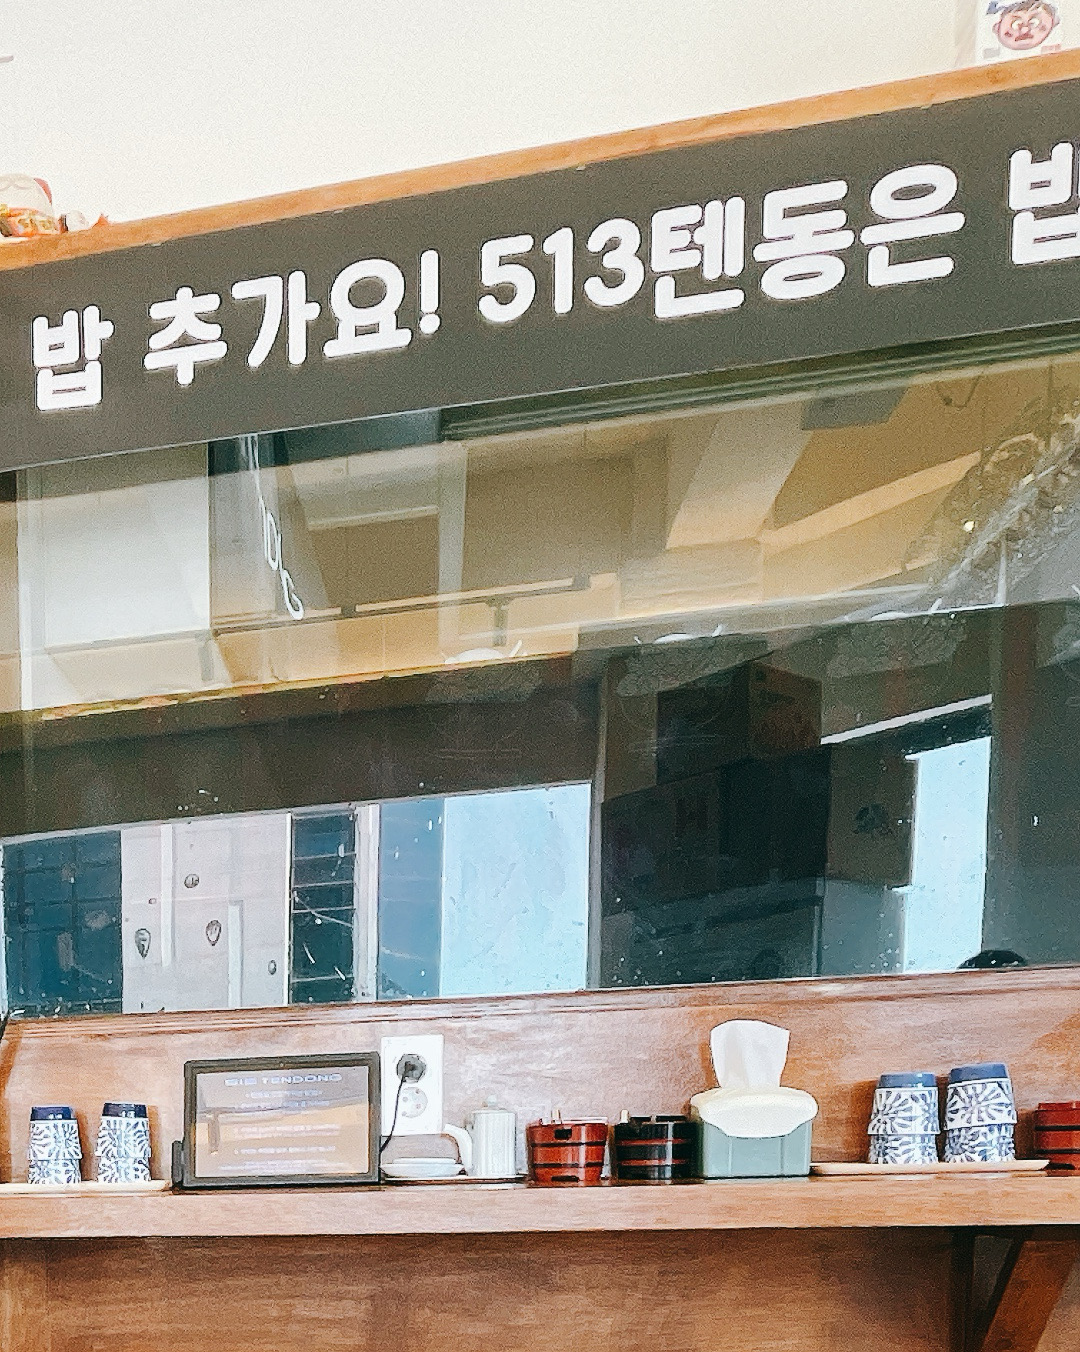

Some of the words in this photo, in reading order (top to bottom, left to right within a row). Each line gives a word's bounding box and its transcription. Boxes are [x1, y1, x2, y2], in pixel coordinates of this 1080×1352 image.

[32, 304, 115, 411] 밥
[143, 249, 442, 386] 추가요!
[478, 163, 966, 324] 513텐동은
